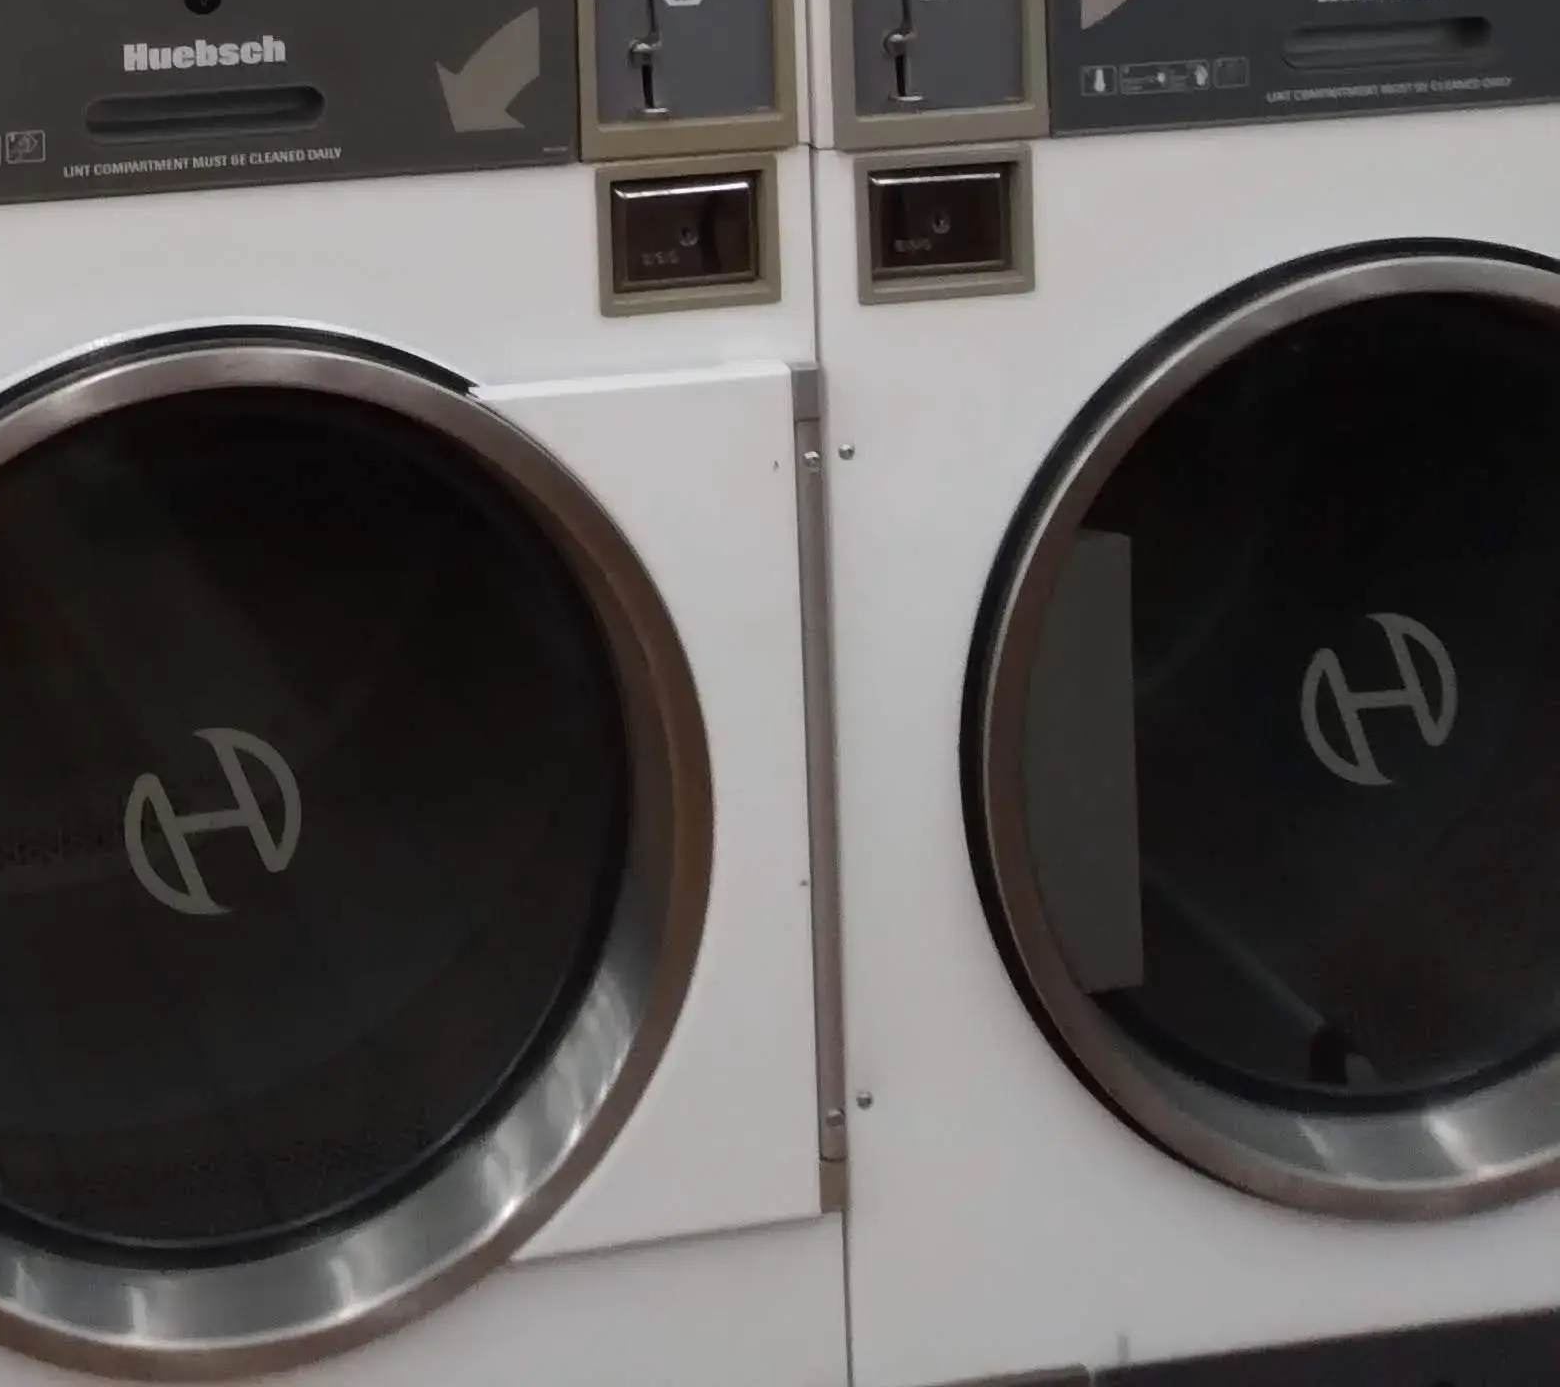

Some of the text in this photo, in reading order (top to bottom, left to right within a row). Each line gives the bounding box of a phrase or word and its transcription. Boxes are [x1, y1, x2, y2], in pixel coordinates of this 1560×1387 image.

[122, 34, 287, 72] Huebsch
[63, 147, 342, 178] LINT COMPARTMENT MUST BE CLEANED DAILY
